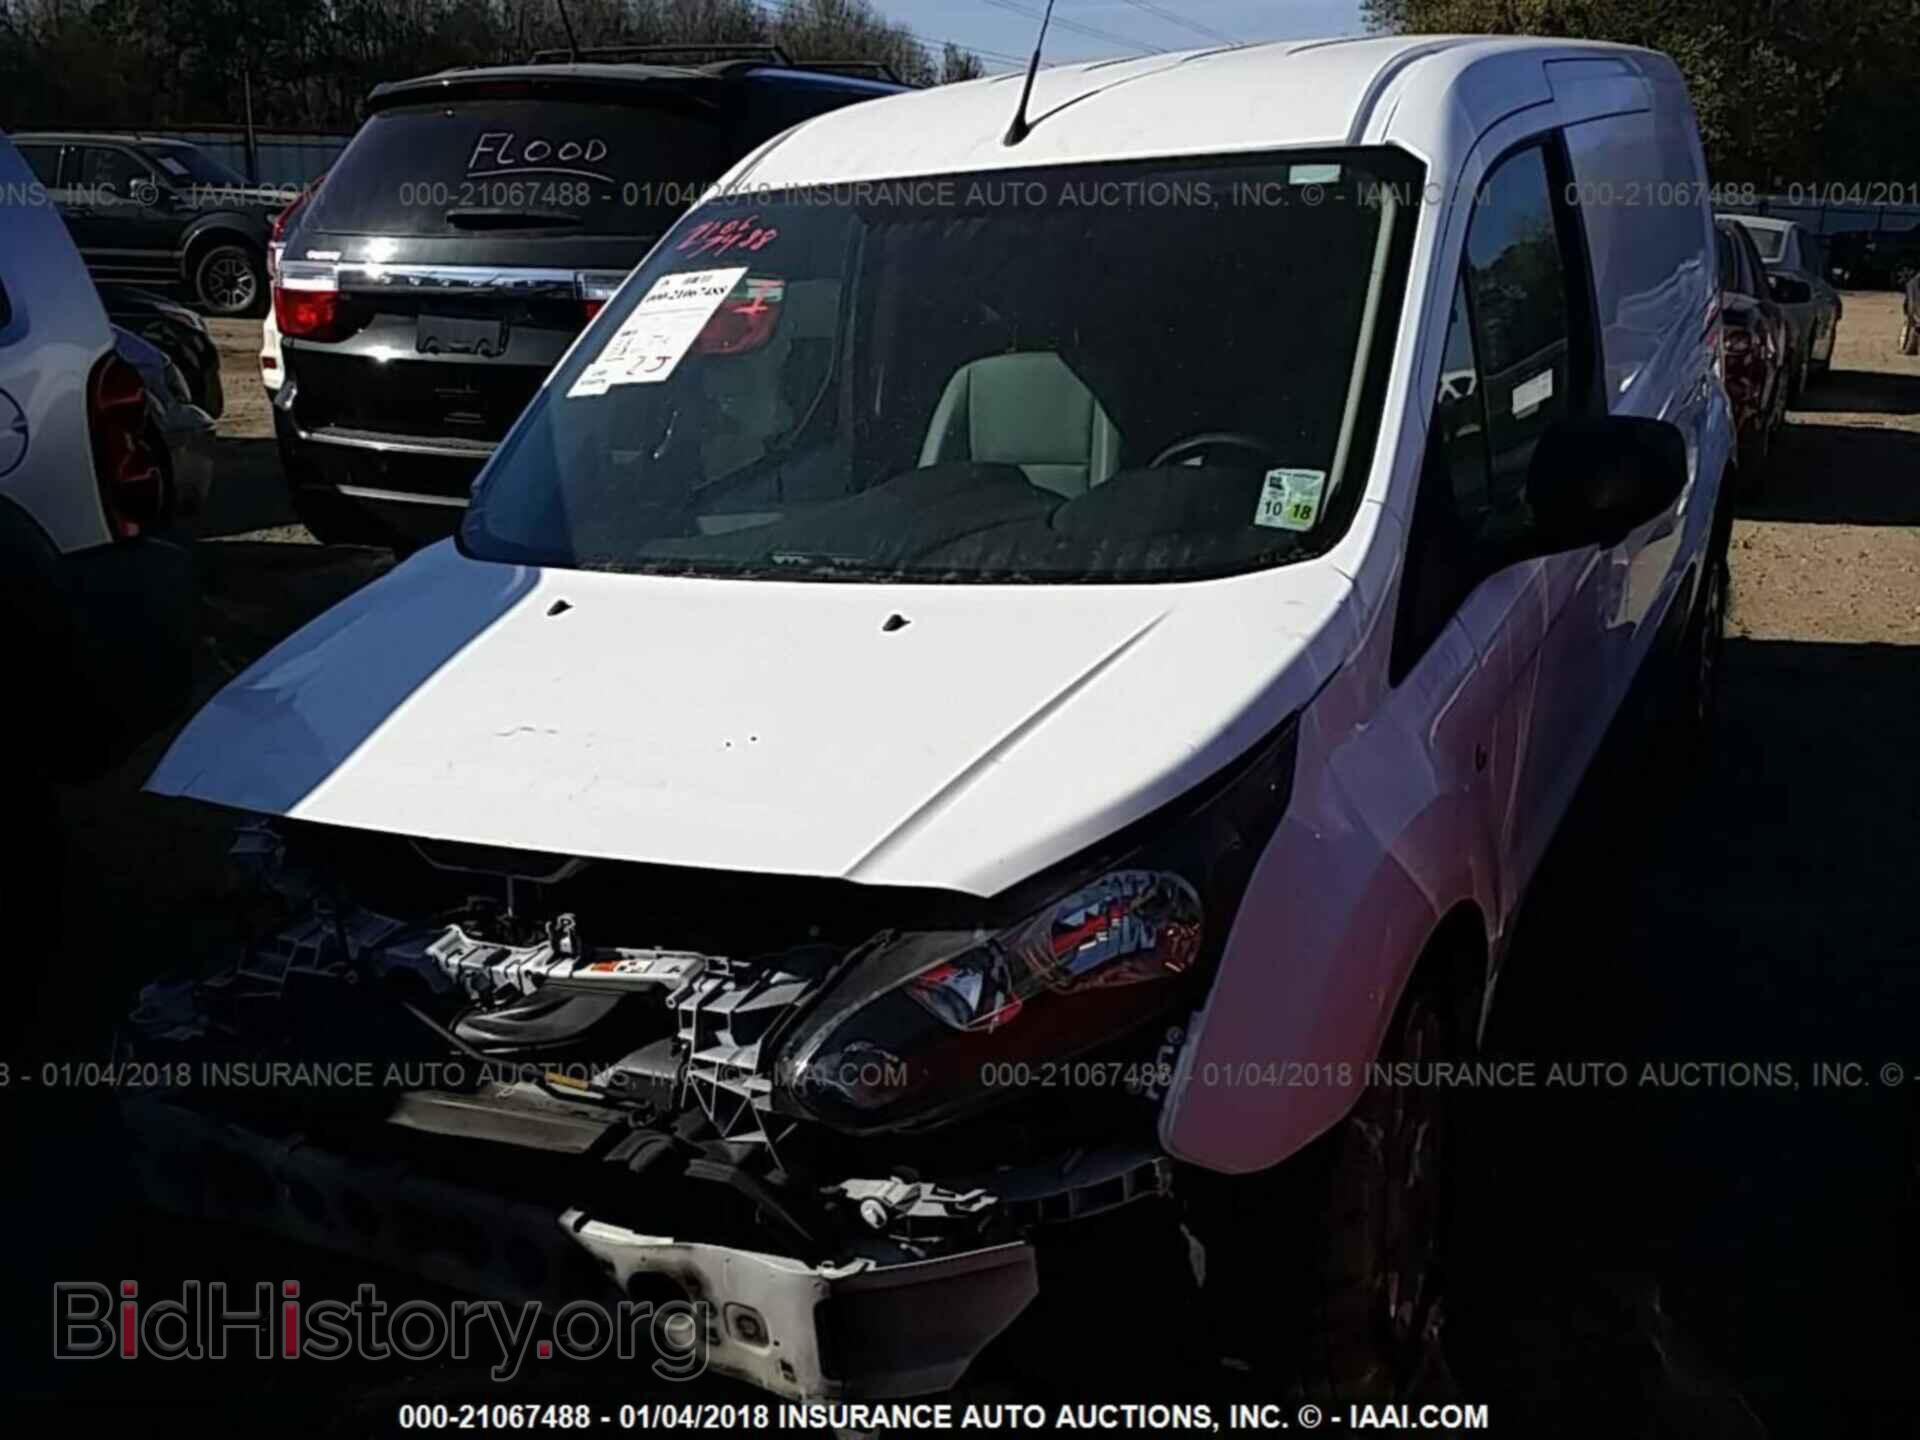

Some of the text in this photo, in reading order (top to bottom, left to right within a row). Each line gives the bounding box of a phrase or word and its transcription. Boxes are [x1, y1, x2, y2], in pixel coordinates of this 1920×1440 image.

[467, 132, 607, 168] FLOOD
[1264, 501, 1312, 520] 10 18
